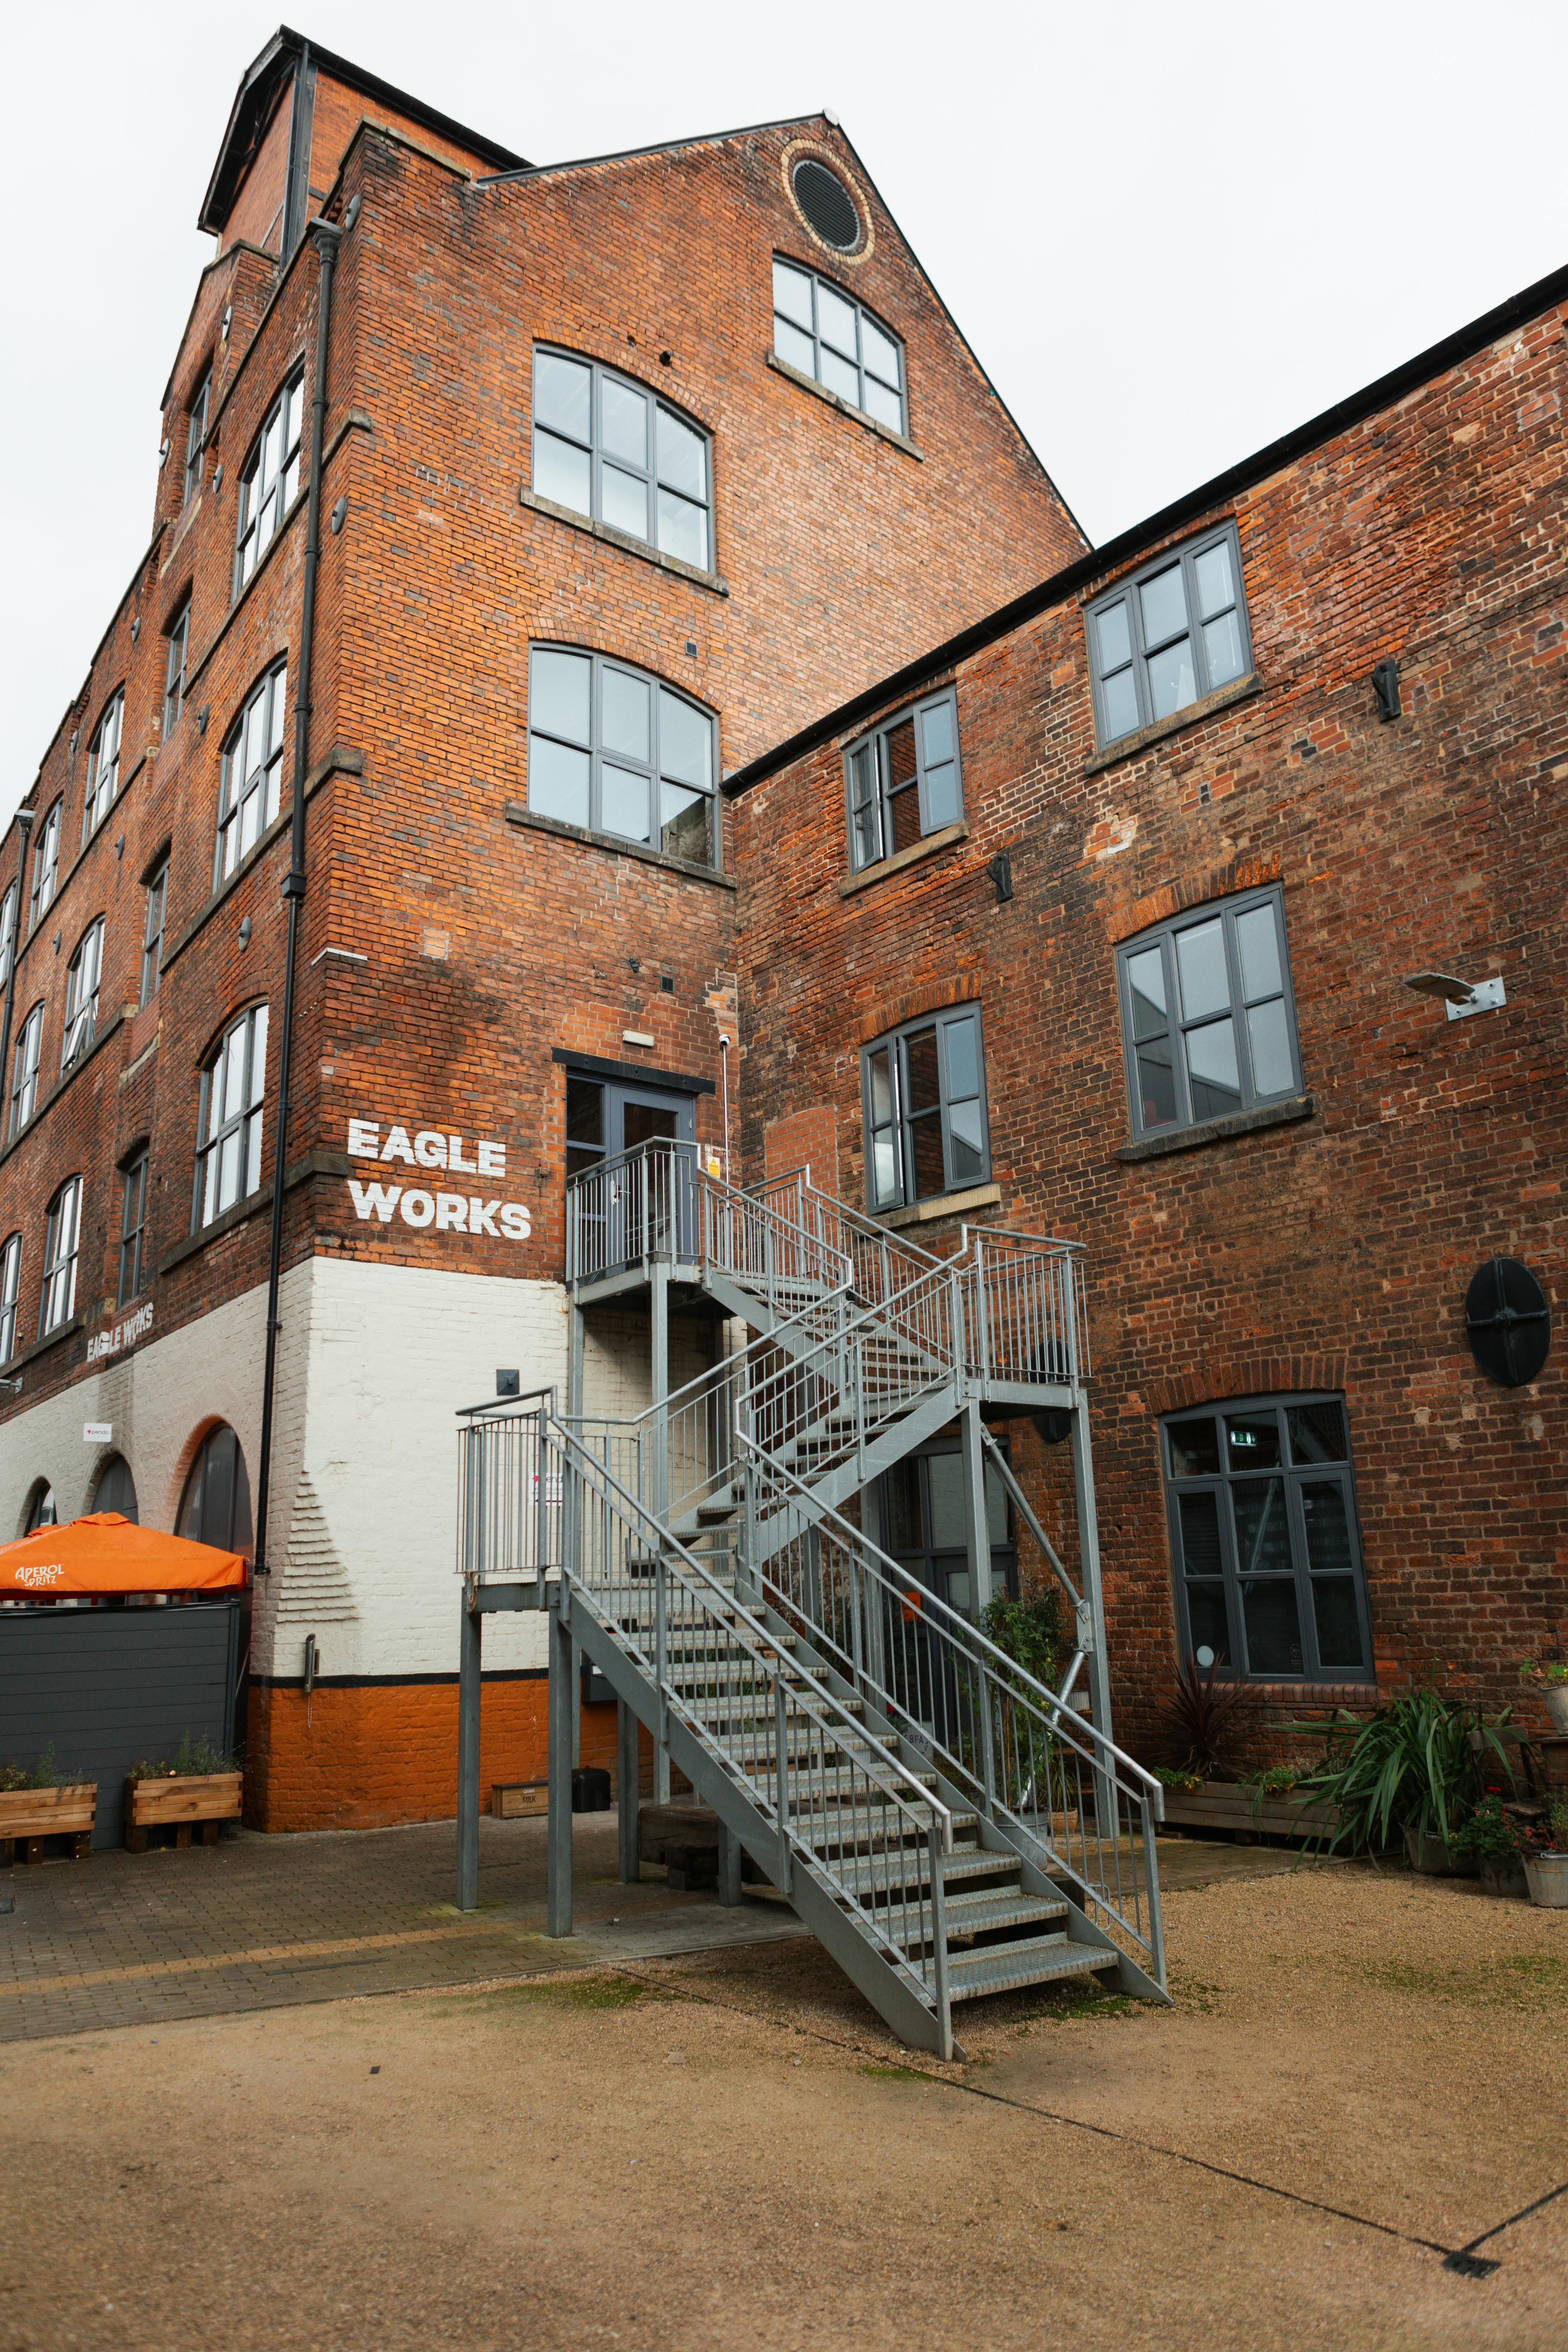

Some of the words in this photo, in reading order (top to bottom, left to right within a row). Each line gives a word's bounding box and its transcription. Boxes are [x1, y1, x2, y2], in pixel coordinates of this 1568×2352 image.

[348, 1118, 506, 1177] EAGLE
[347, 1180, 531, 1240] WORKS
[87, 1325, 121, 1363] EAGLE
[15, 1564, 65, 1580] APEROL
[24, 1574, 56, 1586] SPRITZ
[909, 1735, 924, 1744] BFA
